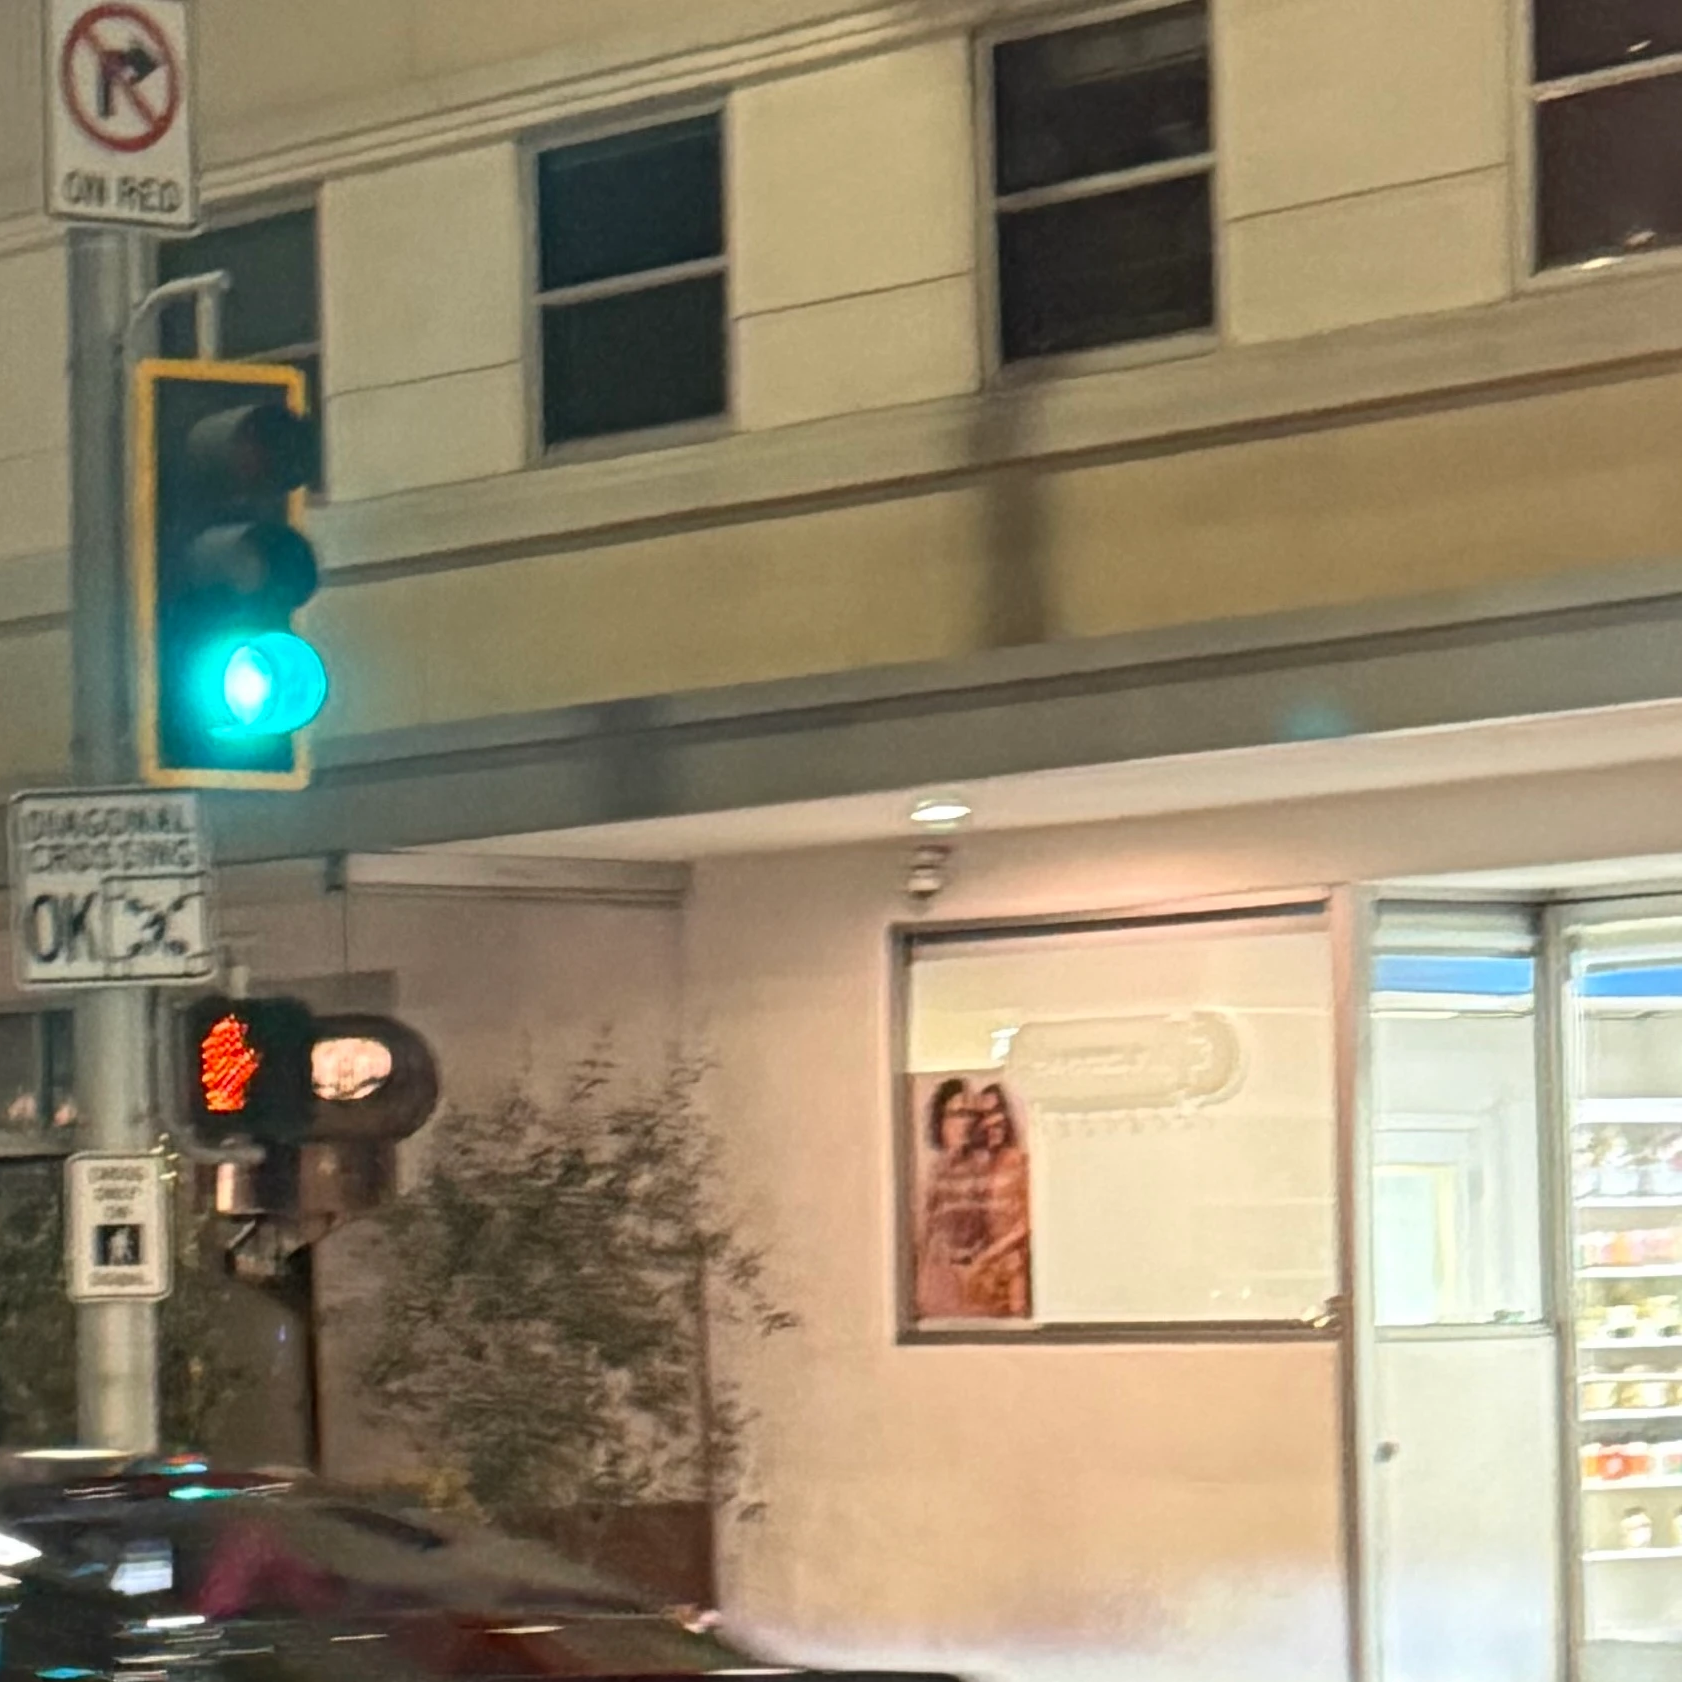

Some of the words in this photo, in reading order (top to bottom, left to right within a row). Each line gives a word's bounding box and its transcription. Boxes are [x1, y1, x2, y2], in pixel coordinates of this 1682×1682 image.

[62, 169, 106, 207] ON
[119, 174, 185, 214] RED
[24, 806, 191, 841] DIAGONAL
[30, 837, 192, 873] CROSSING
[24, 893, 98, 963] OK
